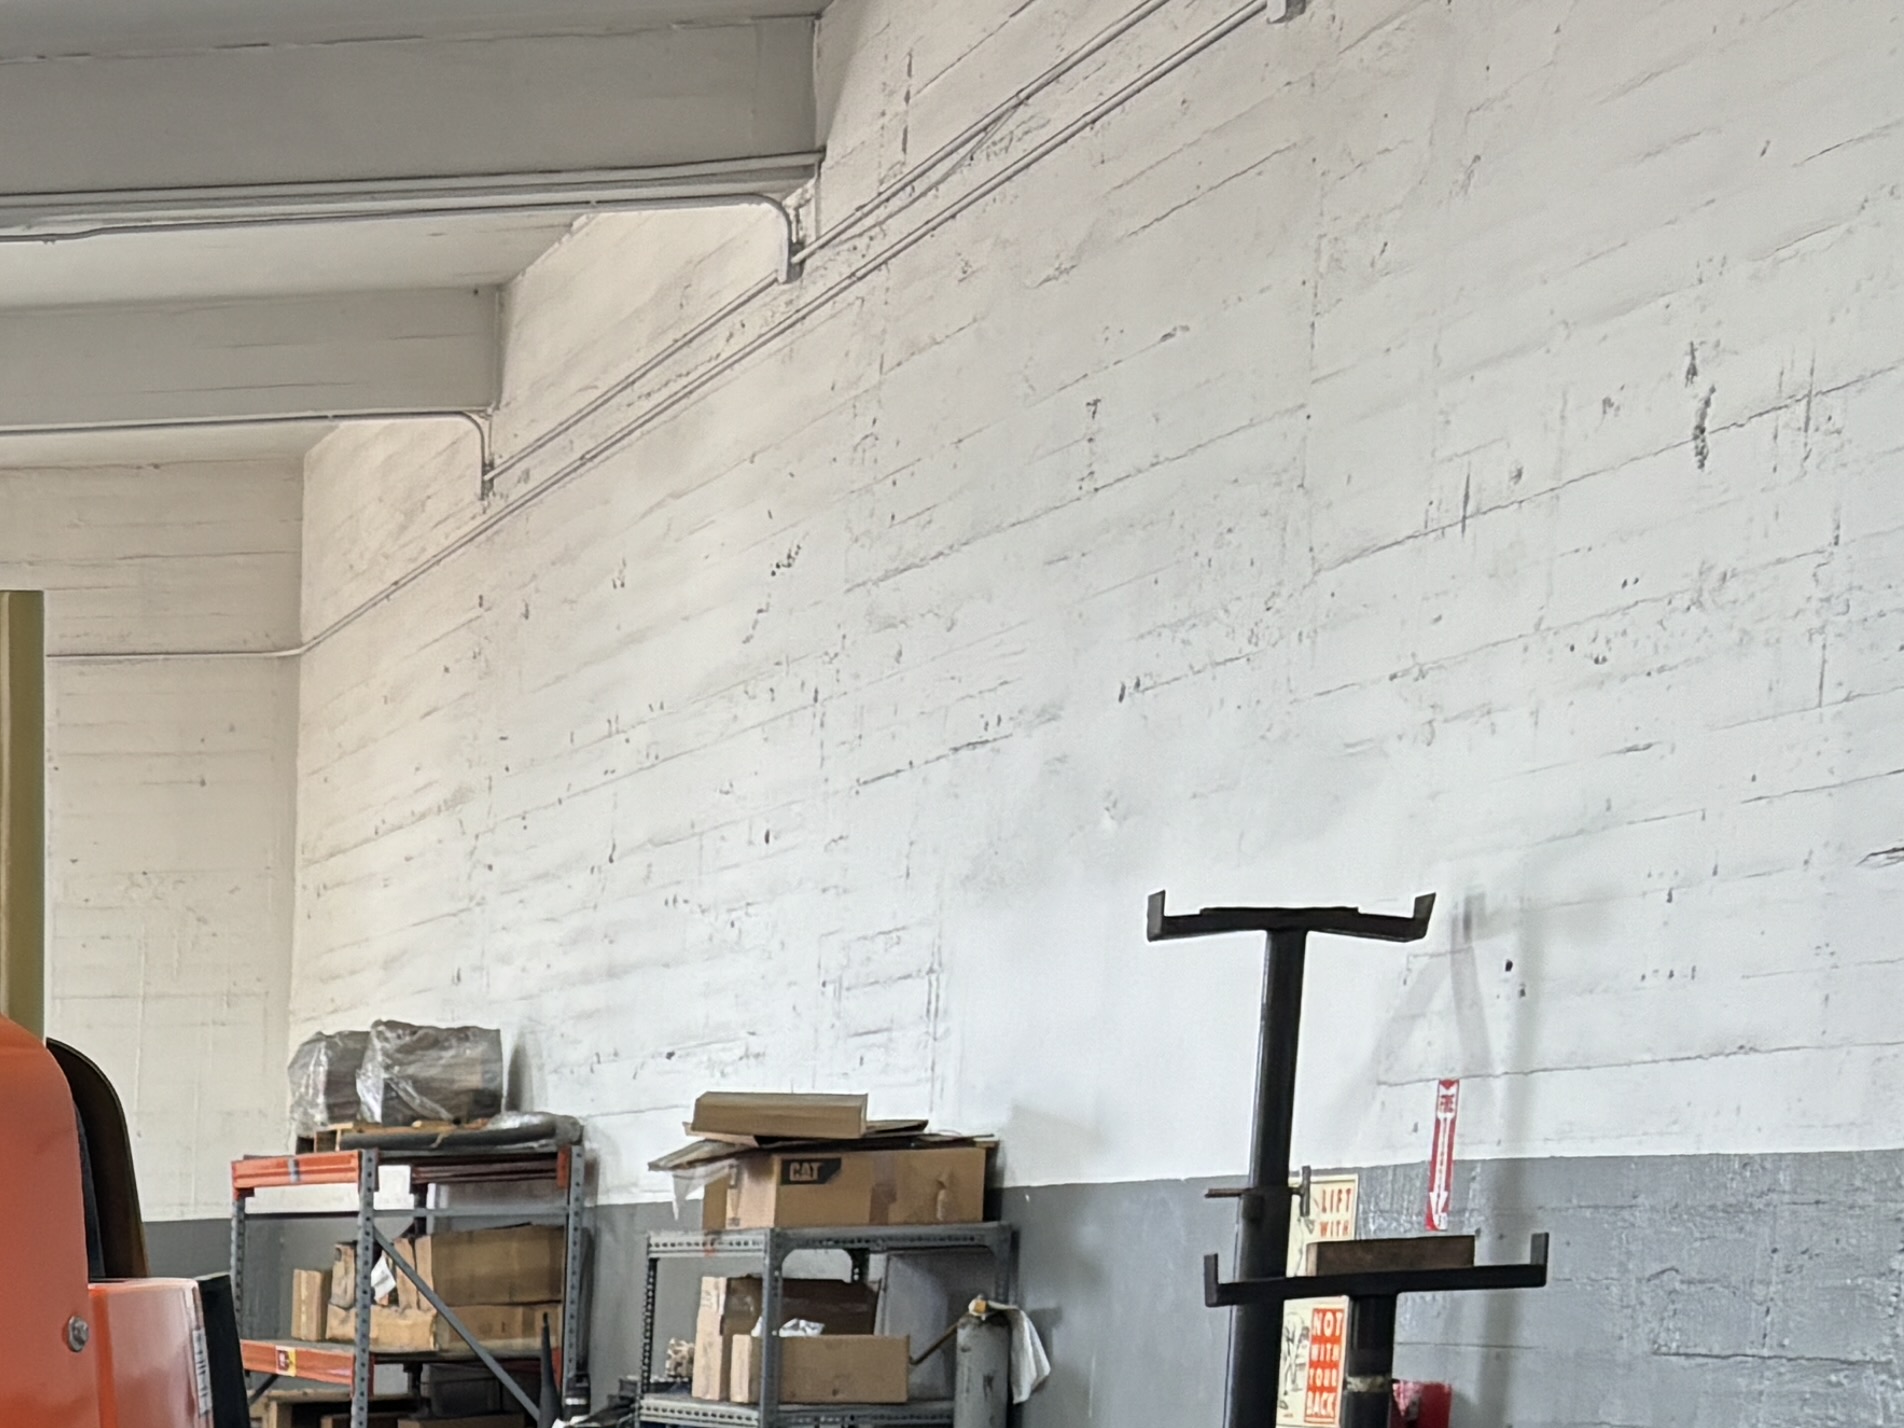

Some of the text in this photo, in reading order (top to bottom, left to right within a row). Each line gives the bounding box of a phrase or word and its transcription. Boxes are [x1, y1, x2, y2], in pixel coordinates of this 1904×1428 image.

[789, 1161, 823, 1182] CAT
[1321, 1187, 1352, 1214] LIFT
[1319, 1220, 1350, 1239] WITH
[1313, 1311, 1343, 1337] NOT
[1311, 1343, 1340, 1362] WITH
[1308, 1368, 1338, 1387] YOUR
[1306, 1391, 1336, 1418] BACK
